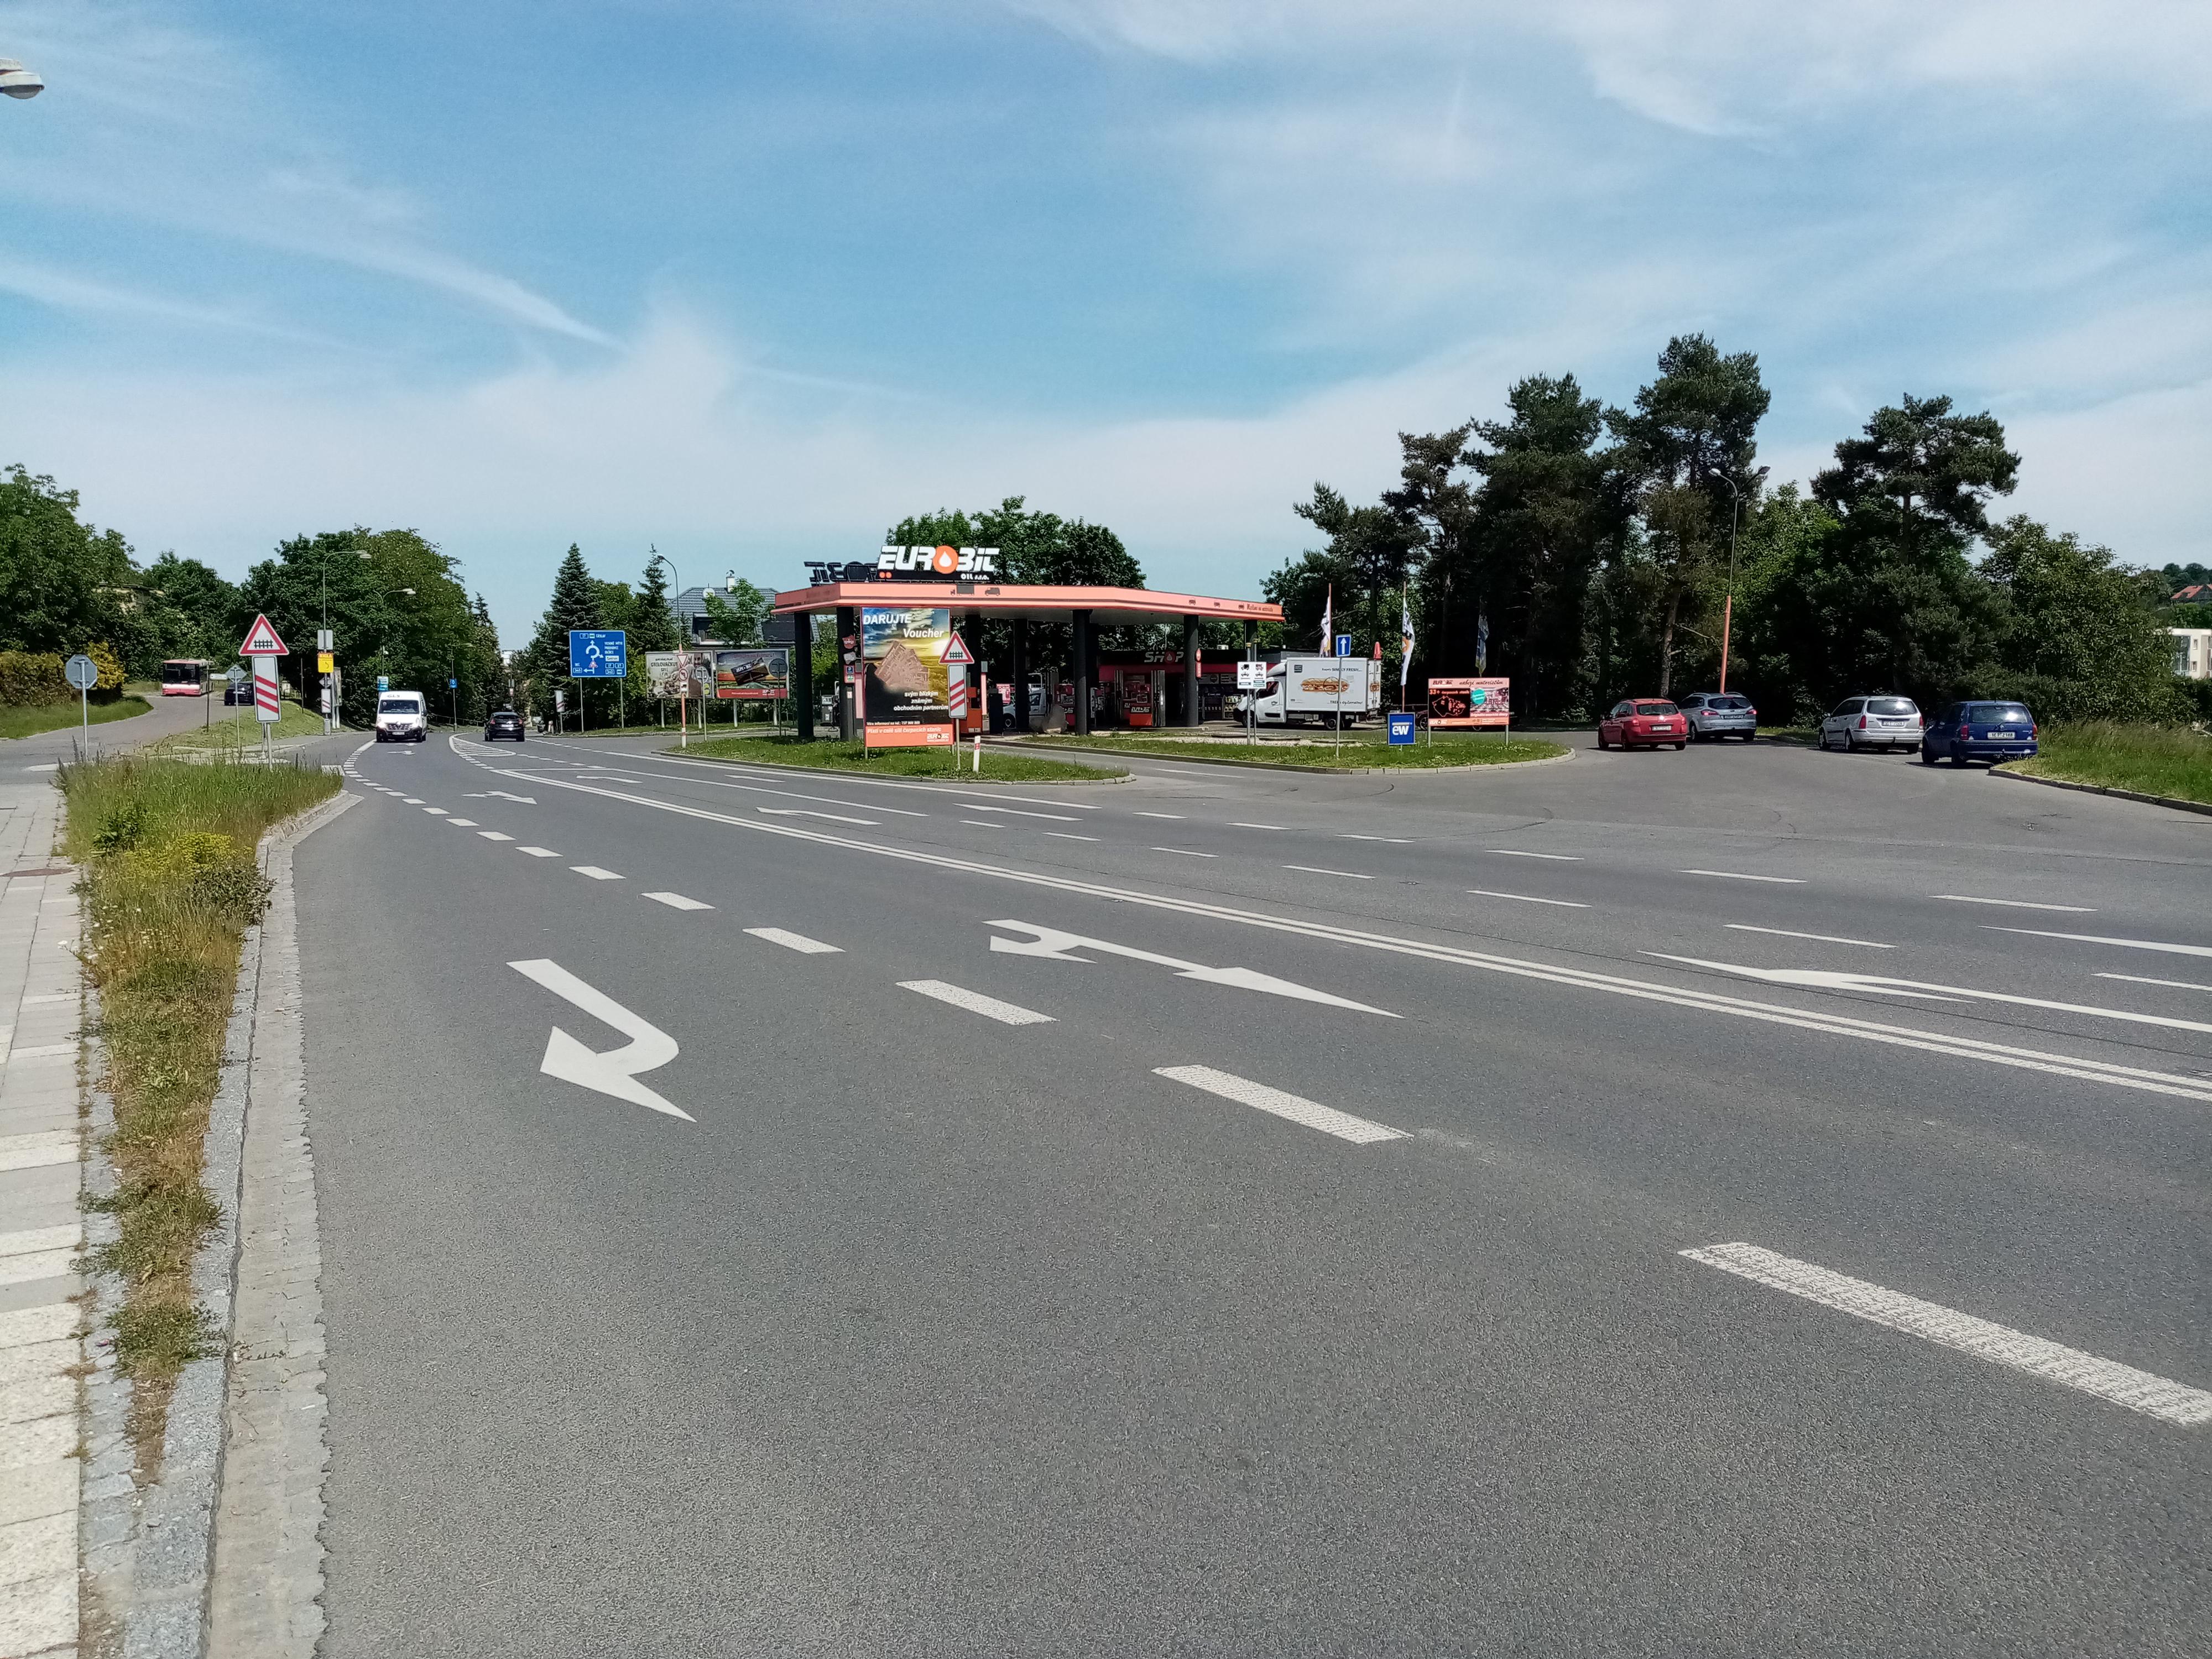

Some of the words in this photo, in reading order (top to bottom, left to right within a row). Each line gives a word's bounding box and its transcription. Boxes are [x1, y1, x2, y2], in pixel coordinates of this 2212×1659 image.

[863, 614, 912, 624] DARUJTE
[903, 628, 944, 637] Voucher
[1392, 726, 1410, 735] ew
